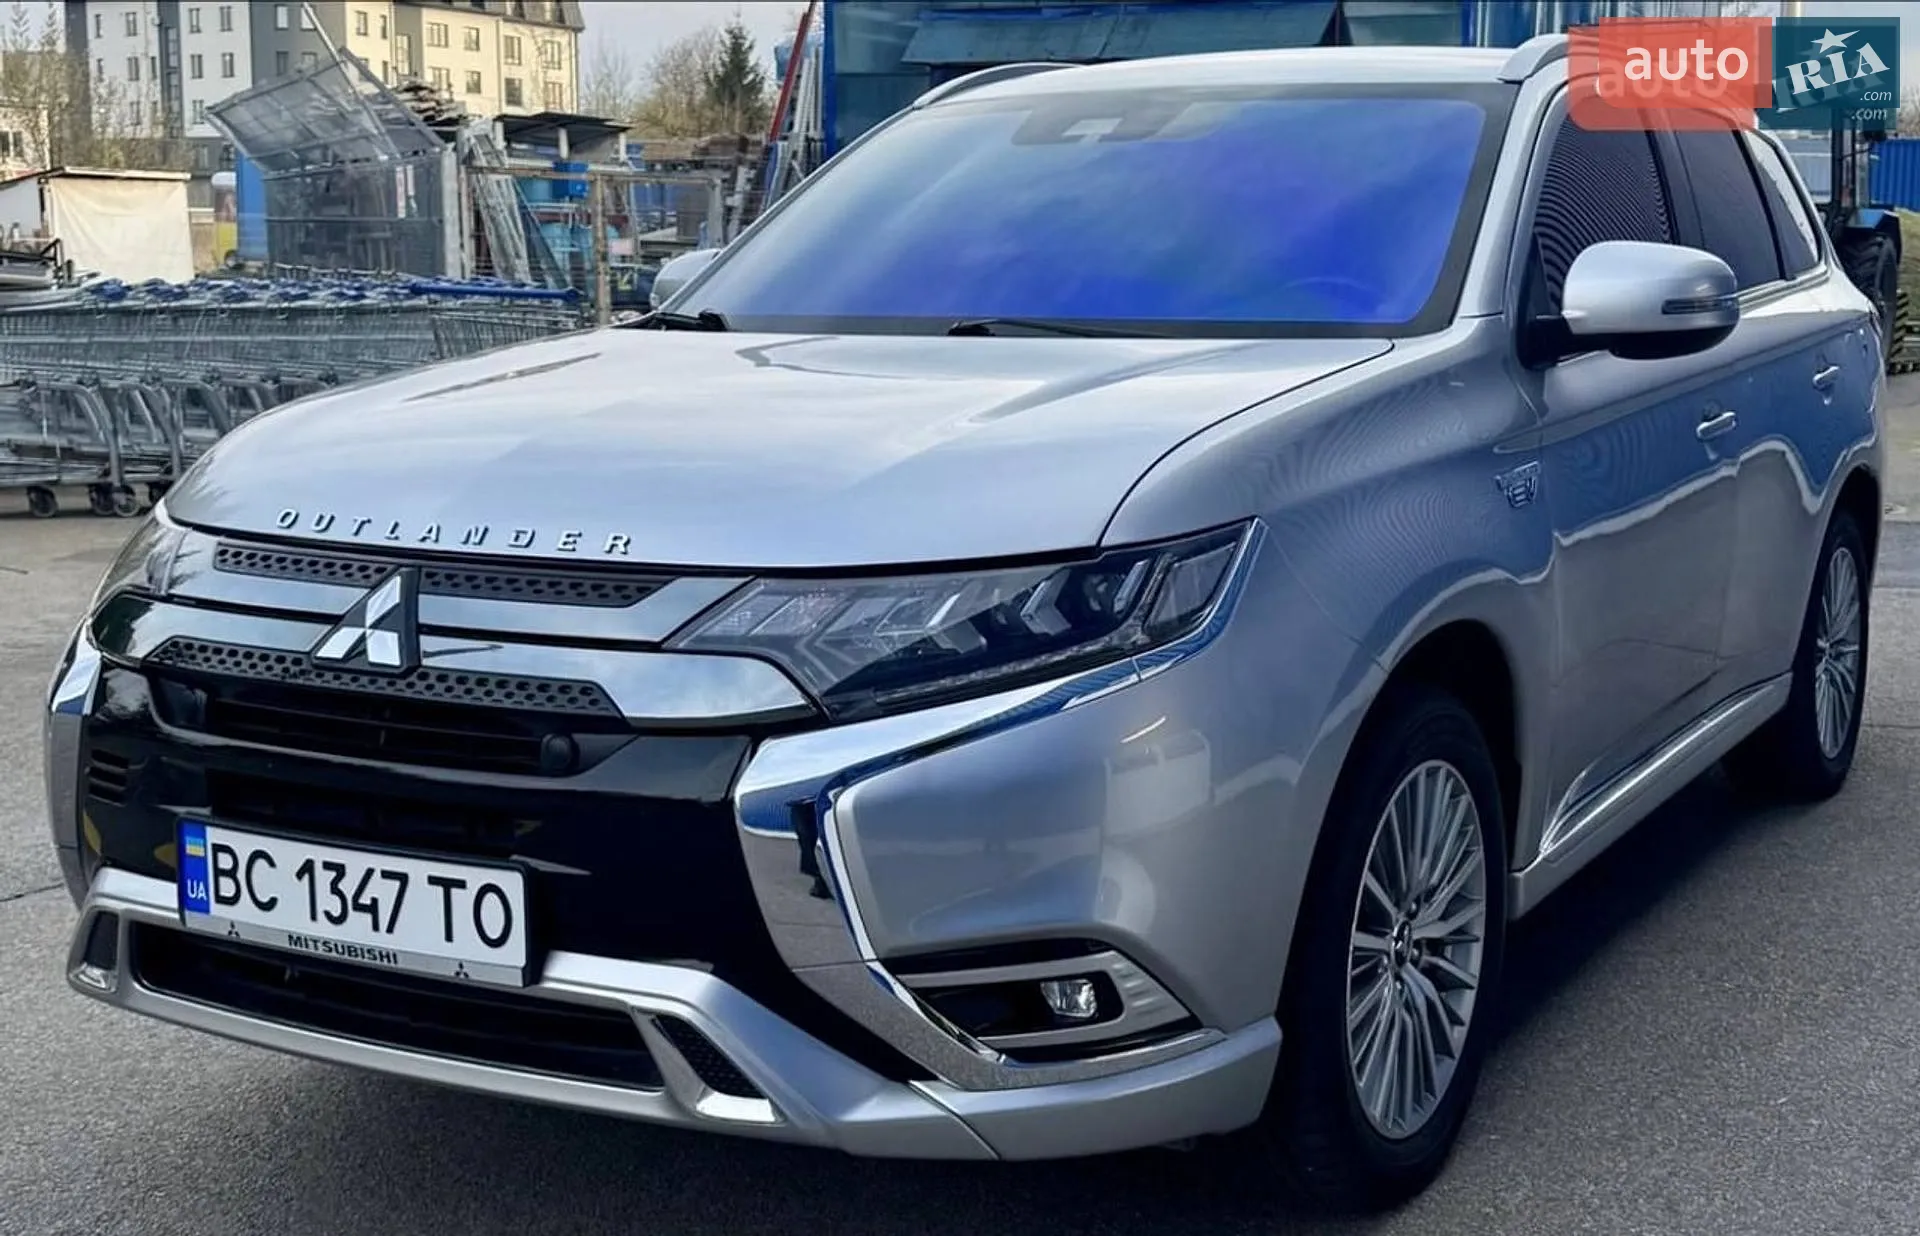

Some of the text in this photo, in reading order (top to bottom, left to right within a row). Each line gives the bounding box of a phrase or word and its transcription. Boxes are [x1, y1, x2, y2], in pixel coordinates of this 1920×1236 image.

[275, 507, 633, 556] OUTLANDER
[187, 879, 207, 901] UA
[211, 843, 513, 949] BC 1347 TO
[288, 934, 399, 966] MITSUBISHI
